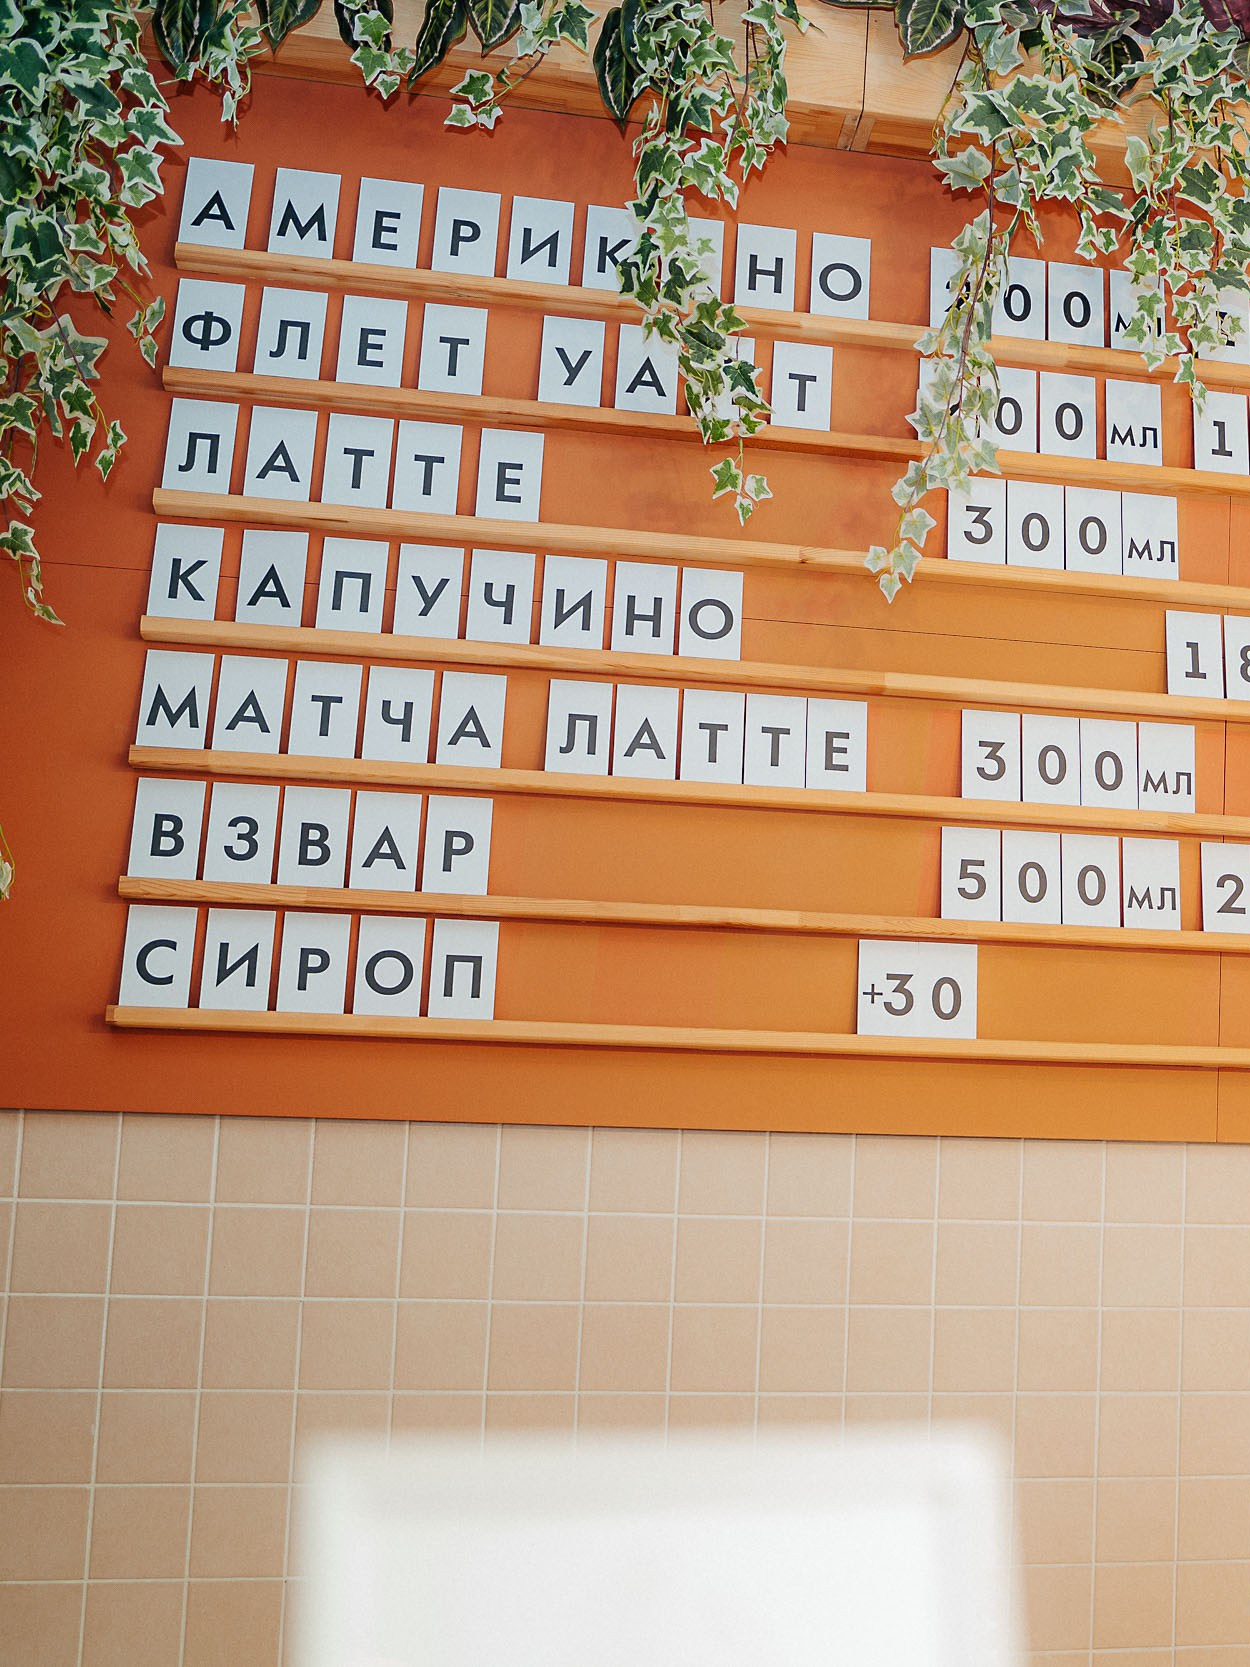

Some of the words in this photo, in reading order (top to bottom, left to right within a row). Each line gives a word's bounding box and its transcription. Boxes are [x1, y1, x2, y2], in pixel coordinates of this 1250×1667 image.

[190, 190, 861, 302] АМЕРИКНО
[182, 311, 469, 376] ФЛЕТ
[555, 346, 816, 411] УАТ
[950, 397, 1157, 448] 00мл
[178, 432, 523, 503] ЛАТТЕ
[964, 505, 1176, 563] 300мл
[168, 558, 733, 639] КАПУЧИНО
[146, 684, 491, 748] МАТЧА
[560, 713, 849, 772] ЛАТТЕ
[976, 740, 1192, 796] 300мл
[150, 814, 474, 872] ВЗВАР
[958, 859, 1176, 911] 500мл
[136, 939, 482, 998] СИРОП
[863, 974, 961, 1020] +30
